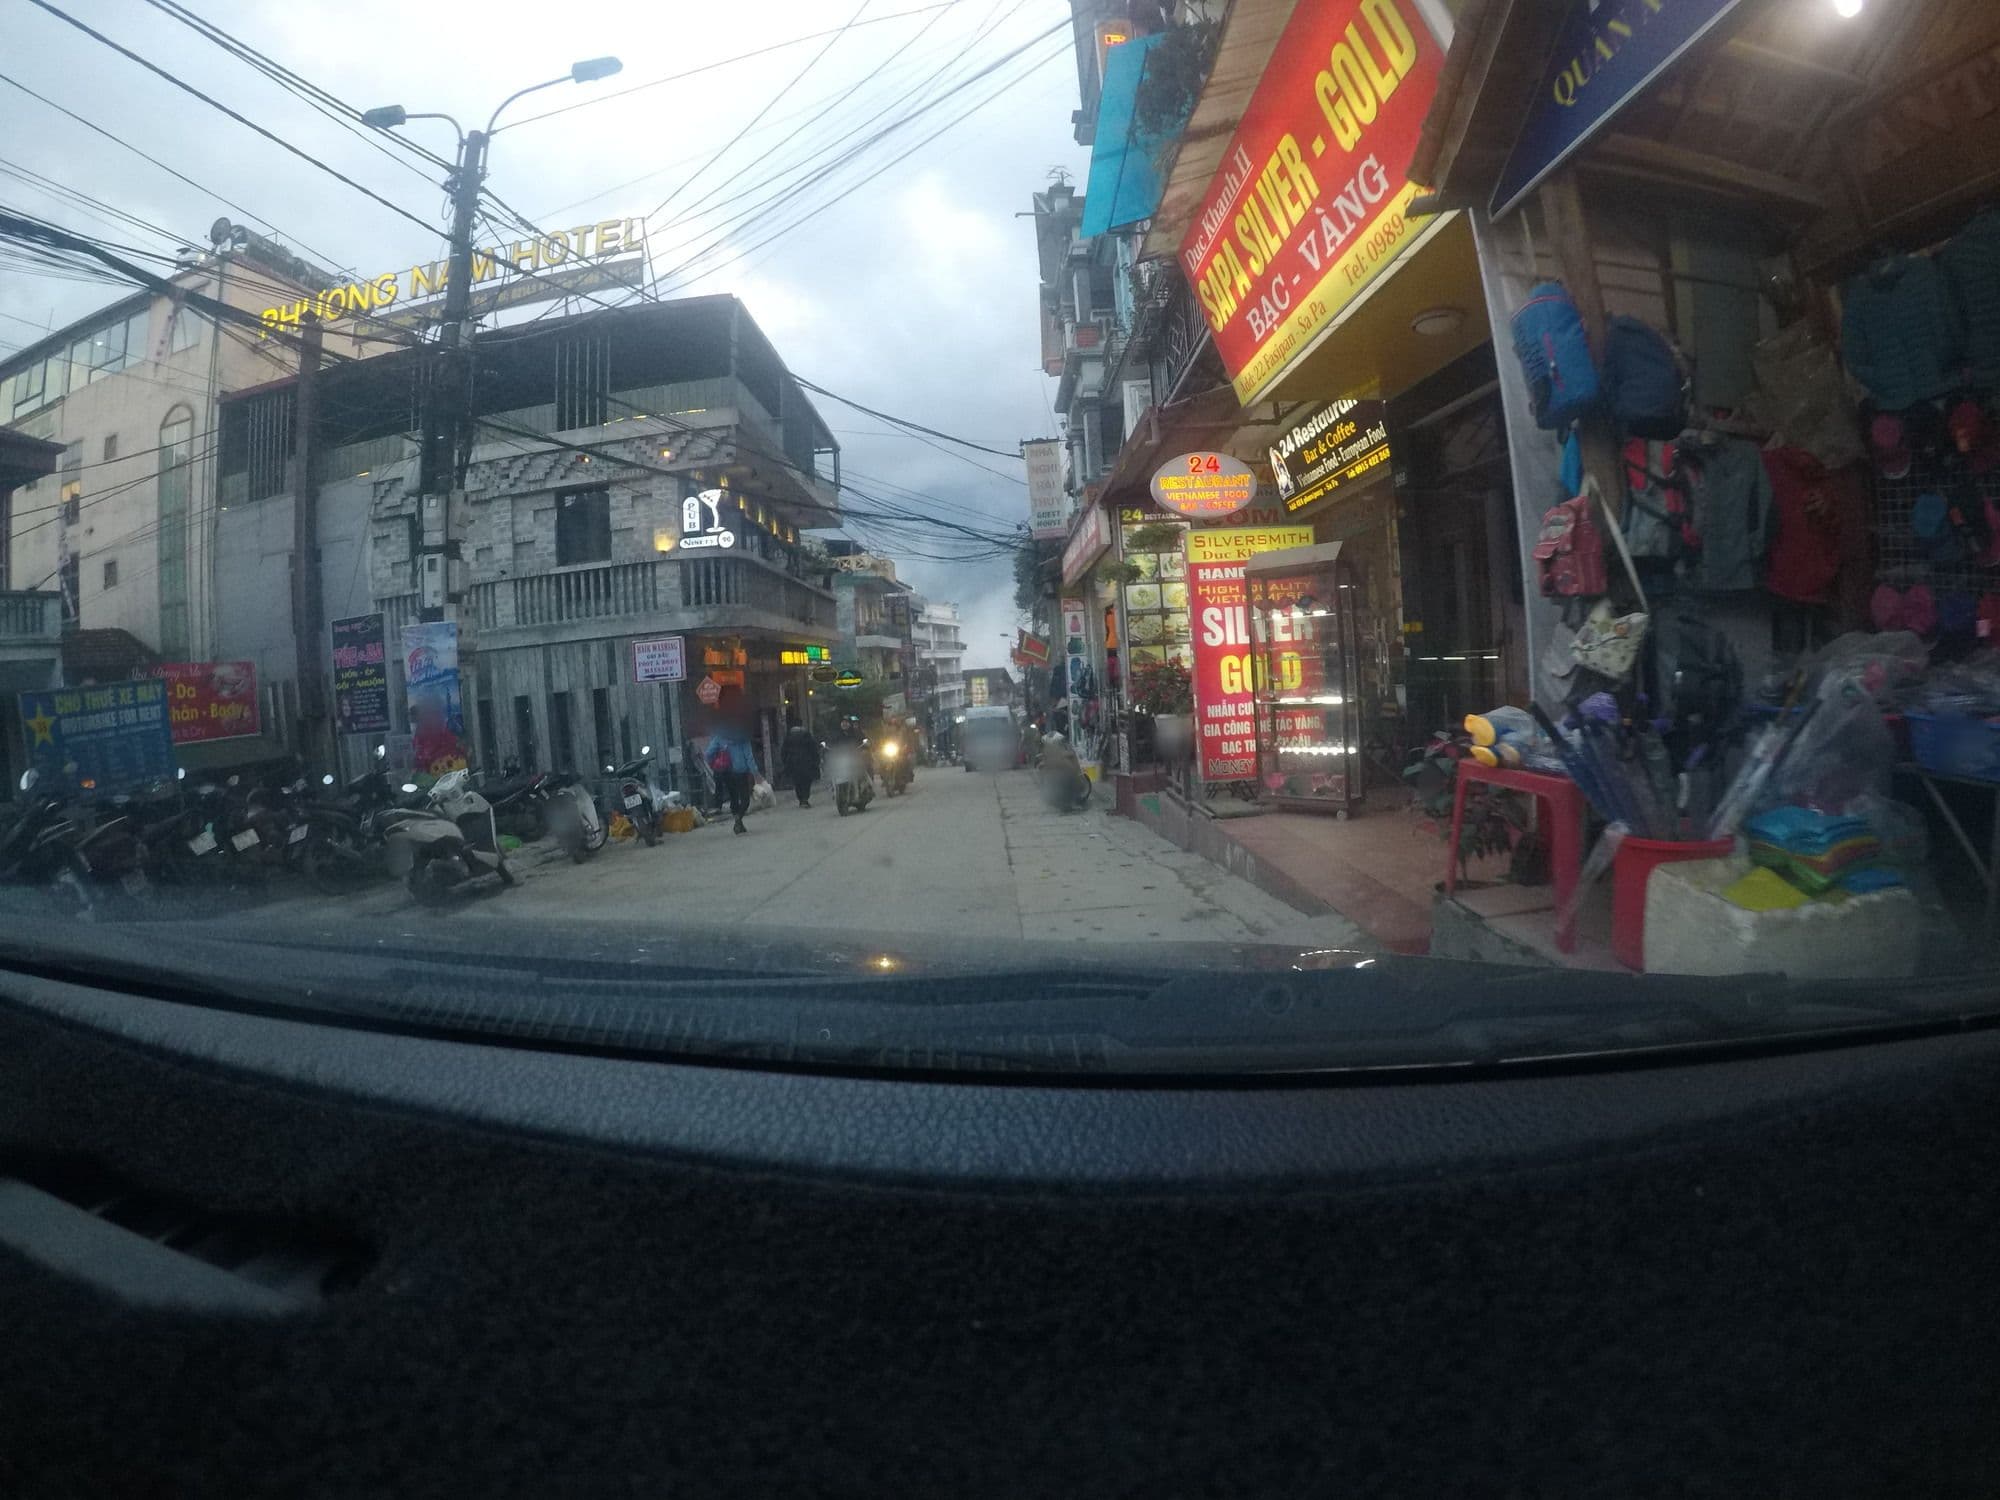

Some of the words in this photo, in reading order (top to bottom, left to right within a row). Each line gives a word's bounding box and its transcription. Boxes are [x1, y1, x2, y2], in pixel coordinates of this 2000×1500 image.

[1197, 238, 1252, 333] SAPA
[1234, 133, 1320, 277] SILVER
[1314, 0, 1416, 152] GOLD
[1184, 234, 1210, 271] Duc
[1200, 168, 1240, 240] Khanh
[511, 218, 644, 269] HOTEL
[1246, 274, 1290, 342] BẠC
[1298, 153, 1389, 271] VÀNG
[1343, 253, 1368, 286] Tel:
[1366, 214, 1405, 261] 0989
[1279, 434, 1295, 458] 24
[1303, 447, 1318, 464] Bar
[1325, 421, 1357, 448] Coffee
[1338, 436, 1370, 462] European
[1366, 420, 1388, 446] Food
[1189, 456, 1220, 473] 24
[1160, 473, 1250, 490] RESTAURANT
[1166, 490, 1220, 501] VIETNAMESE
[1224, 490, 1248, 499] FOOD
[687, 502, 697, 529] PUB
[1121, 509, 1143, 521] 24
[1193, 533, 1310, 548] SILVERSMITH
[1202, 549, 1232, 560] Duc
[1198, 585, 1240, 596] HIGH
[1202, 603, 1314, 647] SILVER
[1220, 651, 1302, 695] GOLD
[176, 683, 197, 699] Da
[1204, 723, 1221, 737] GIA
[1223, 719, 1251, 736] CÔNG
[1222, 741, 1242, 757] BẠC
[1208, 758, 1256, 776] MONEY
